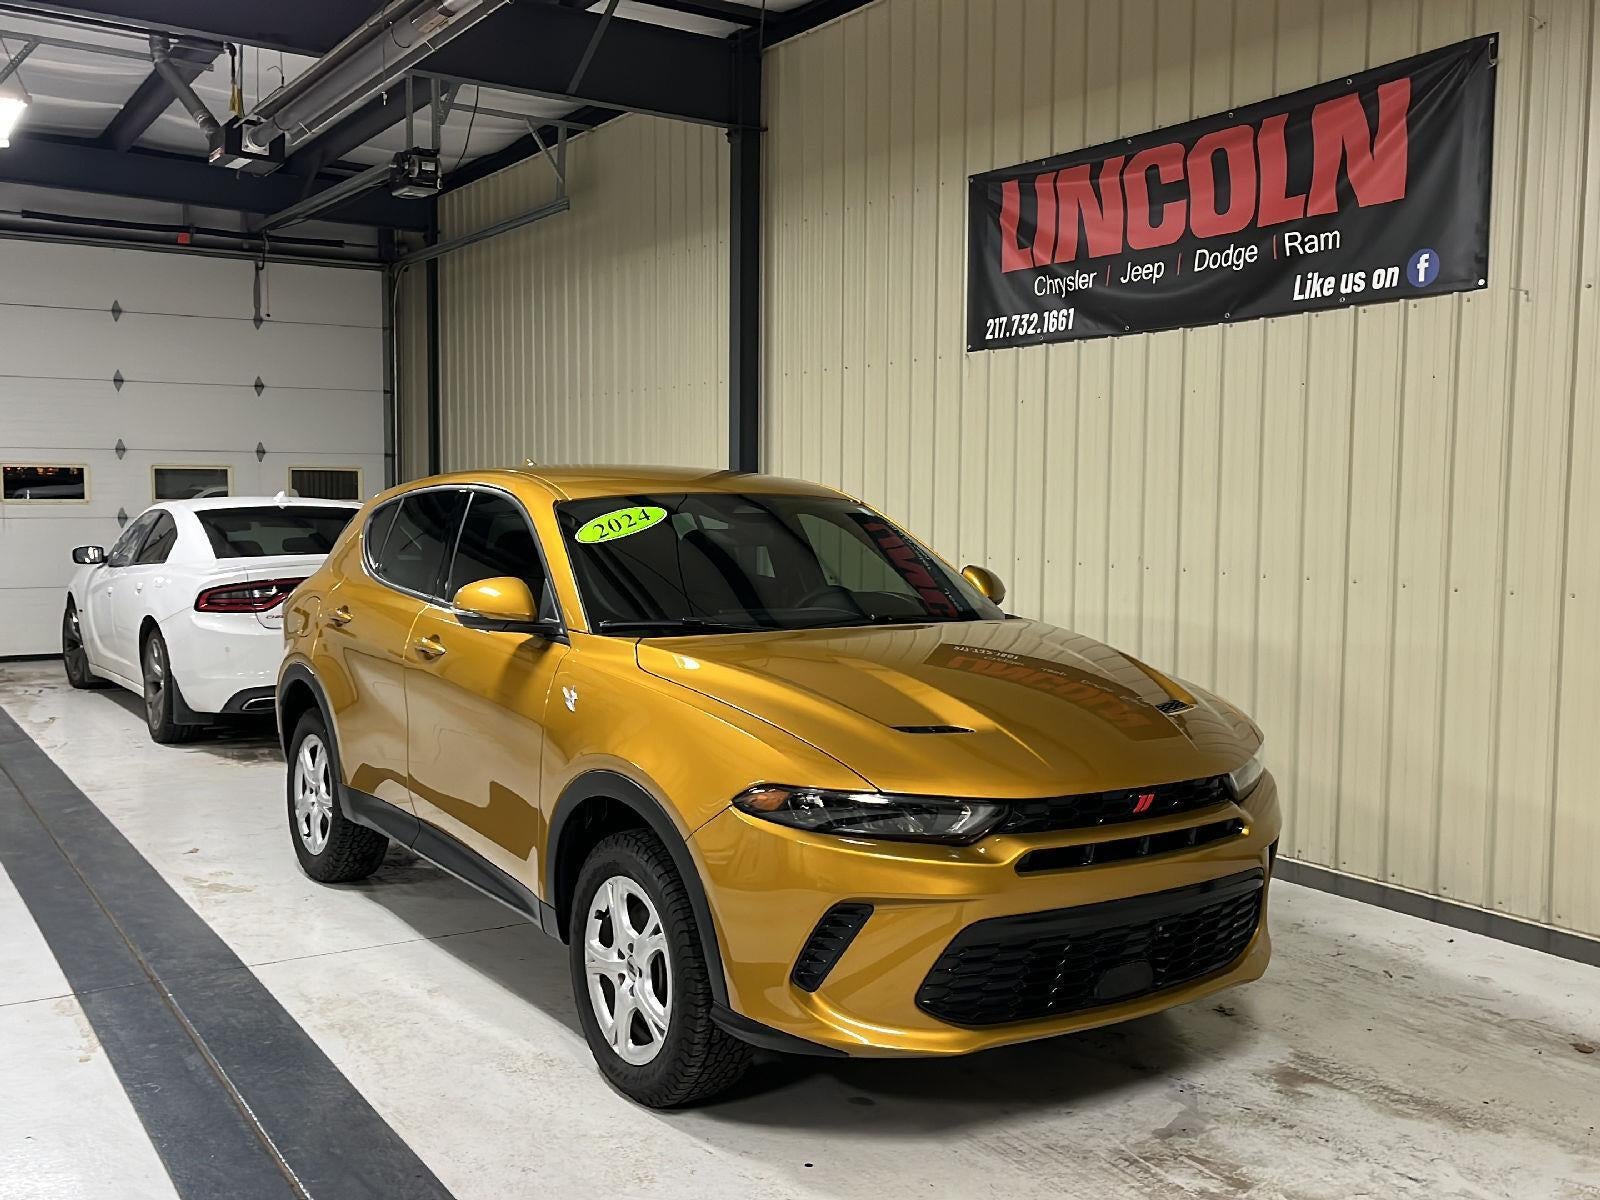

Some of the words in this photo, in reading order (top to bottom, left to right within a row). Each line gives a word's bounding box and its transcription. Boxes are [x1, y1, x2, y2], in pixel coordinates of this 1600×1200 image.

[1000, 77, 1411, 273] LINCOLN
[1034, 269, 1098, 298] Chrysler
[1120, 261, 1165, 284] Jeep
[1193, 243, 1259, 273] Dodge
[1284, 229, 1341, 257] Ram
[1293, 271, 1335, 301] Like
[1339, 270, 1367, 295] us
[1372, 265, 1400, 289] on
[985, 307, 1075, 340] 217.732.1661
[593, 508, 651, 539] 2024
